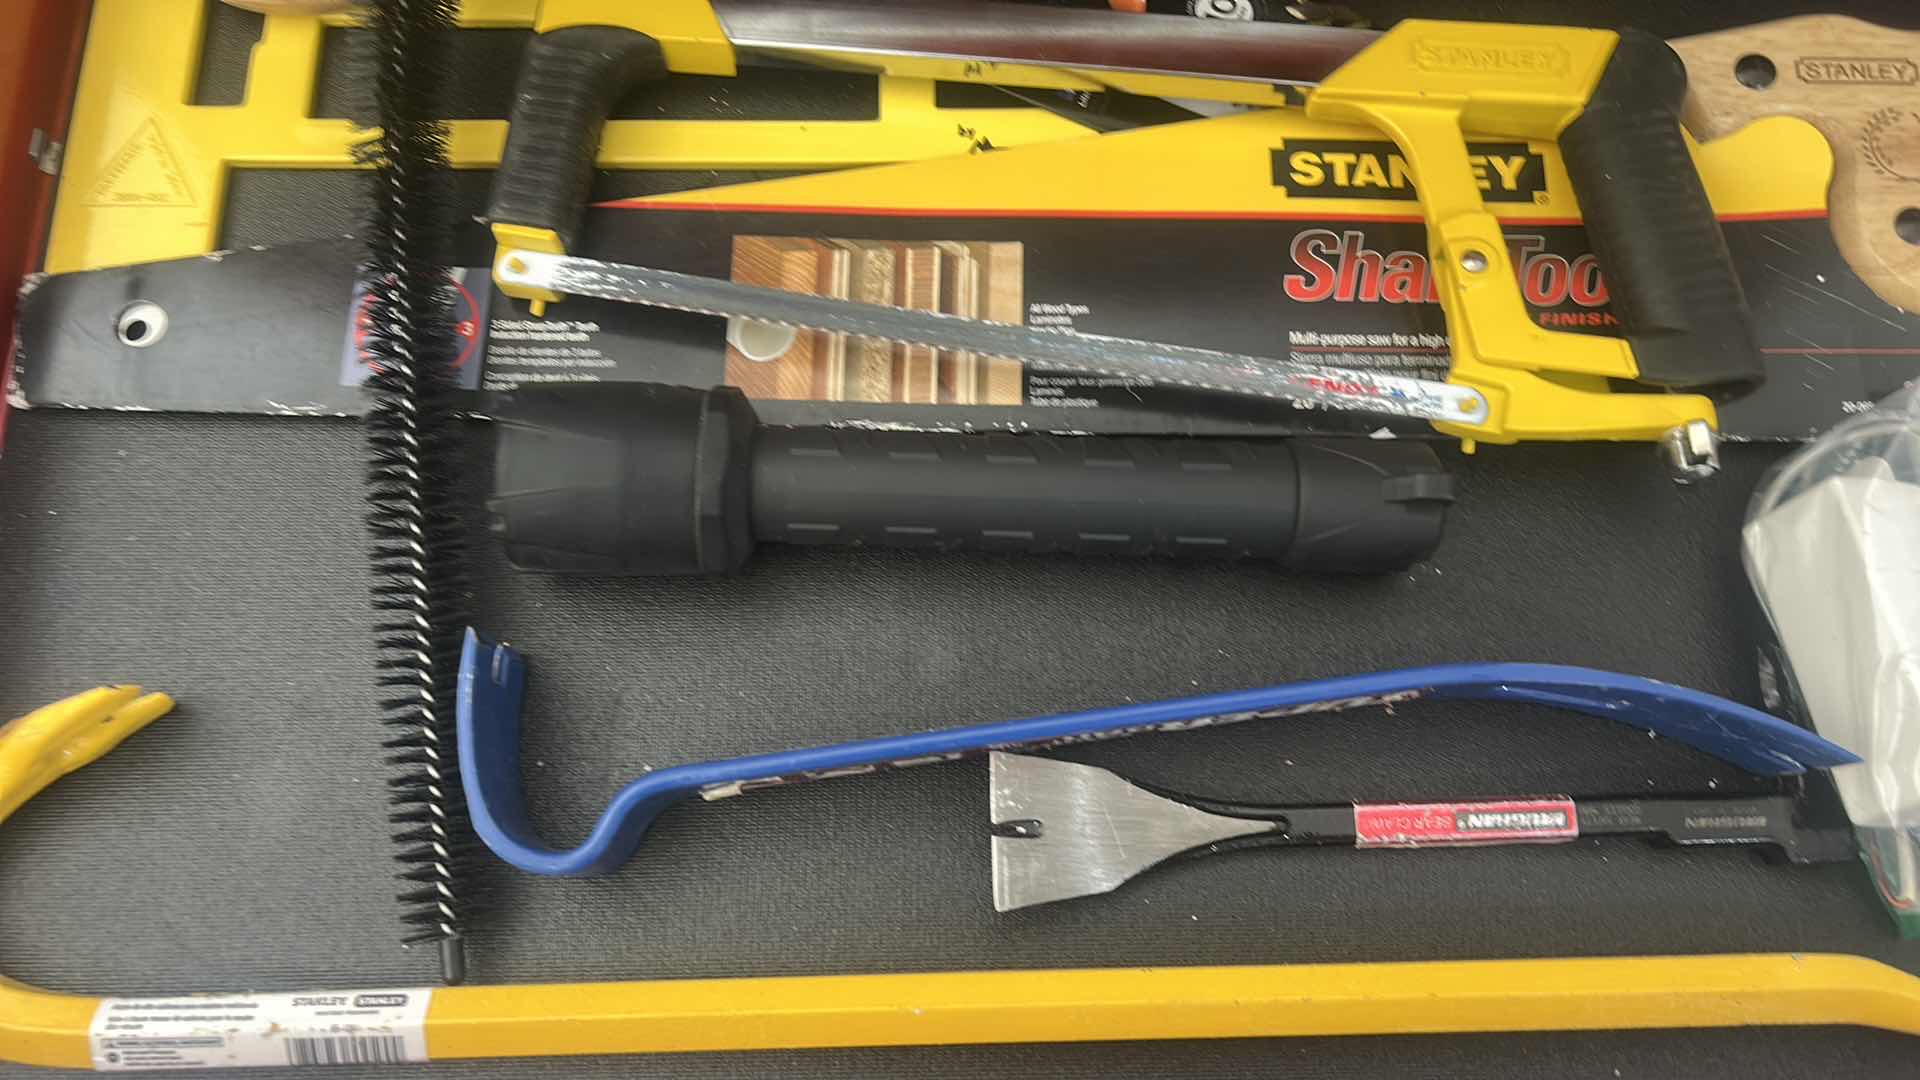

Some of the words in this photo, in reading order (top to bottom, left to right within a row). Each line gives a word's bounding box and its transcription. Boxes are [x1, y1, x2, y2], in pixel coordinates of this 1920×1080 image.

[1415, 47, 1553, 72] STANLEY
[1803, 62, 1908, 81] STANLEY
[1289, 151, 1526, 191] STANEY
[1289, 331, 1366, 348] Multi-purpose
[1367, 335, 1391, 346] saw
[1392, 332, 1409, 347] for
[1409, 336, 1419, 347] a
[1418, 332, 1445, 349] high
